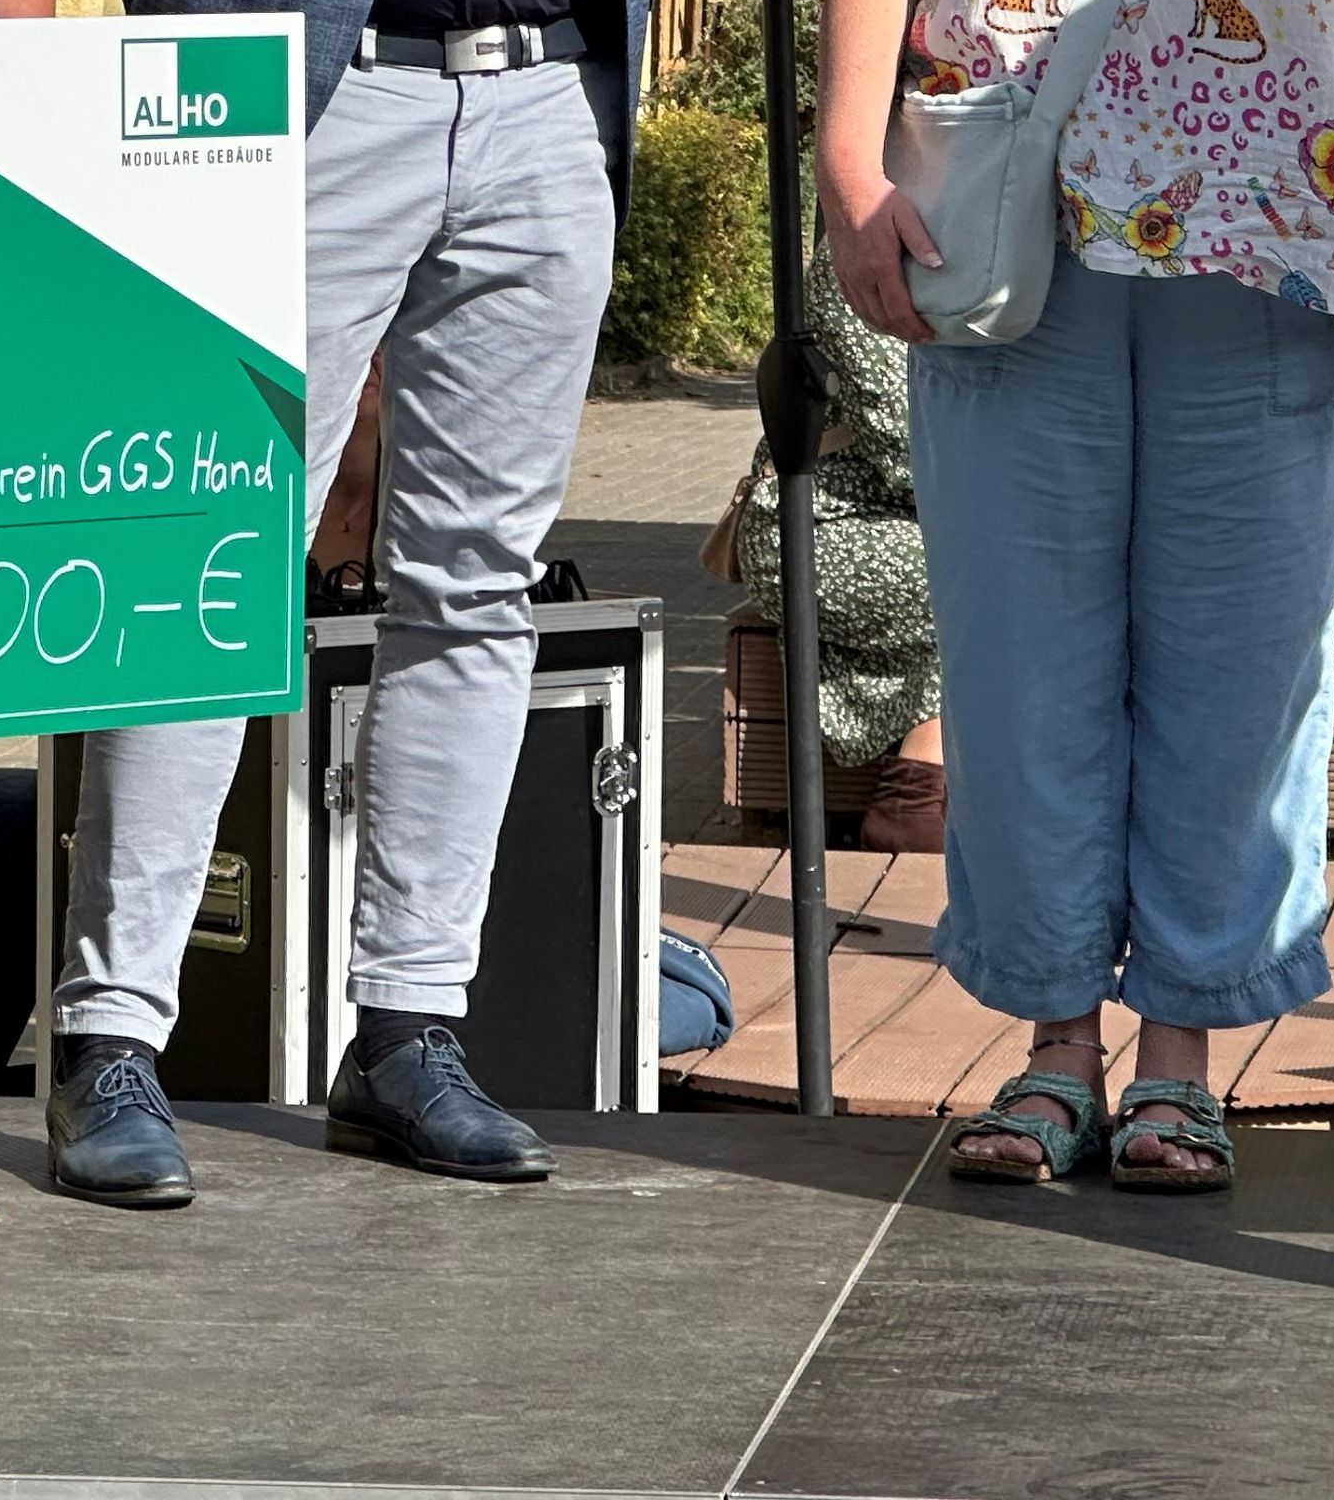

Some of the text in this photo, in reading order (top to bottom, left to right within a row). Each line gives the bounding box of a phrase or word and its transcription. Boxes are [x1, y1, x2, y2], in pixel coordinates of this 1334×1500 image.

[132, 91, 229, 128] ALHO
[121, 146, 273, 167] MODULARE GEBÄUDE
[79, 430, 174, 496] GGS
[190, 430, 275, 494] Hand
